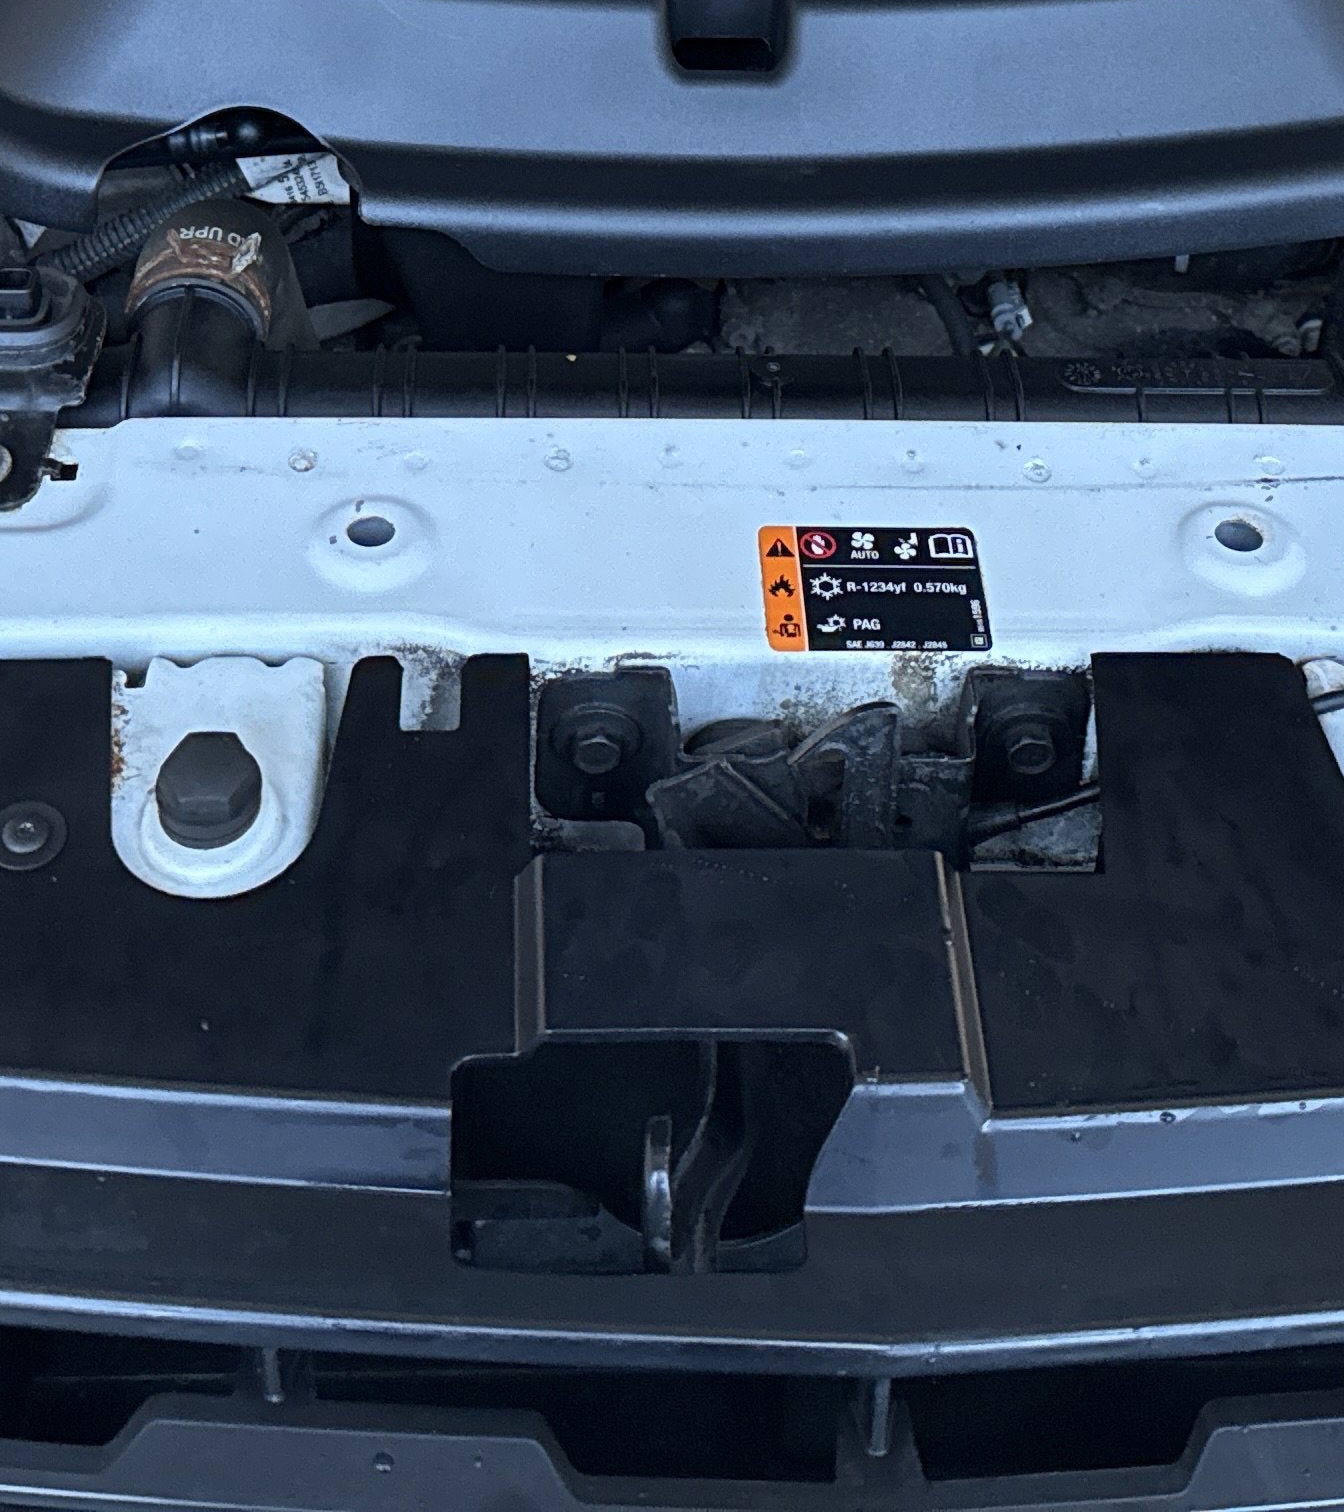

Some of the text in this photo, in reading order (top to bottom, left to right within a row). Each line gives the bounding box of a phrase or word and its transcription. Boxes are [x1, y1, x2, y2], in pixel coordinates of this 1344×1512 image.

[179, 226, 224, 242] UPR
[850, 549, 880, 560] AUTO
[846, 581, 967, 596] R-1234yf 0.570kg
[852, 618, 881, 631] PAG
[845, 640, 863, 649] SAE
